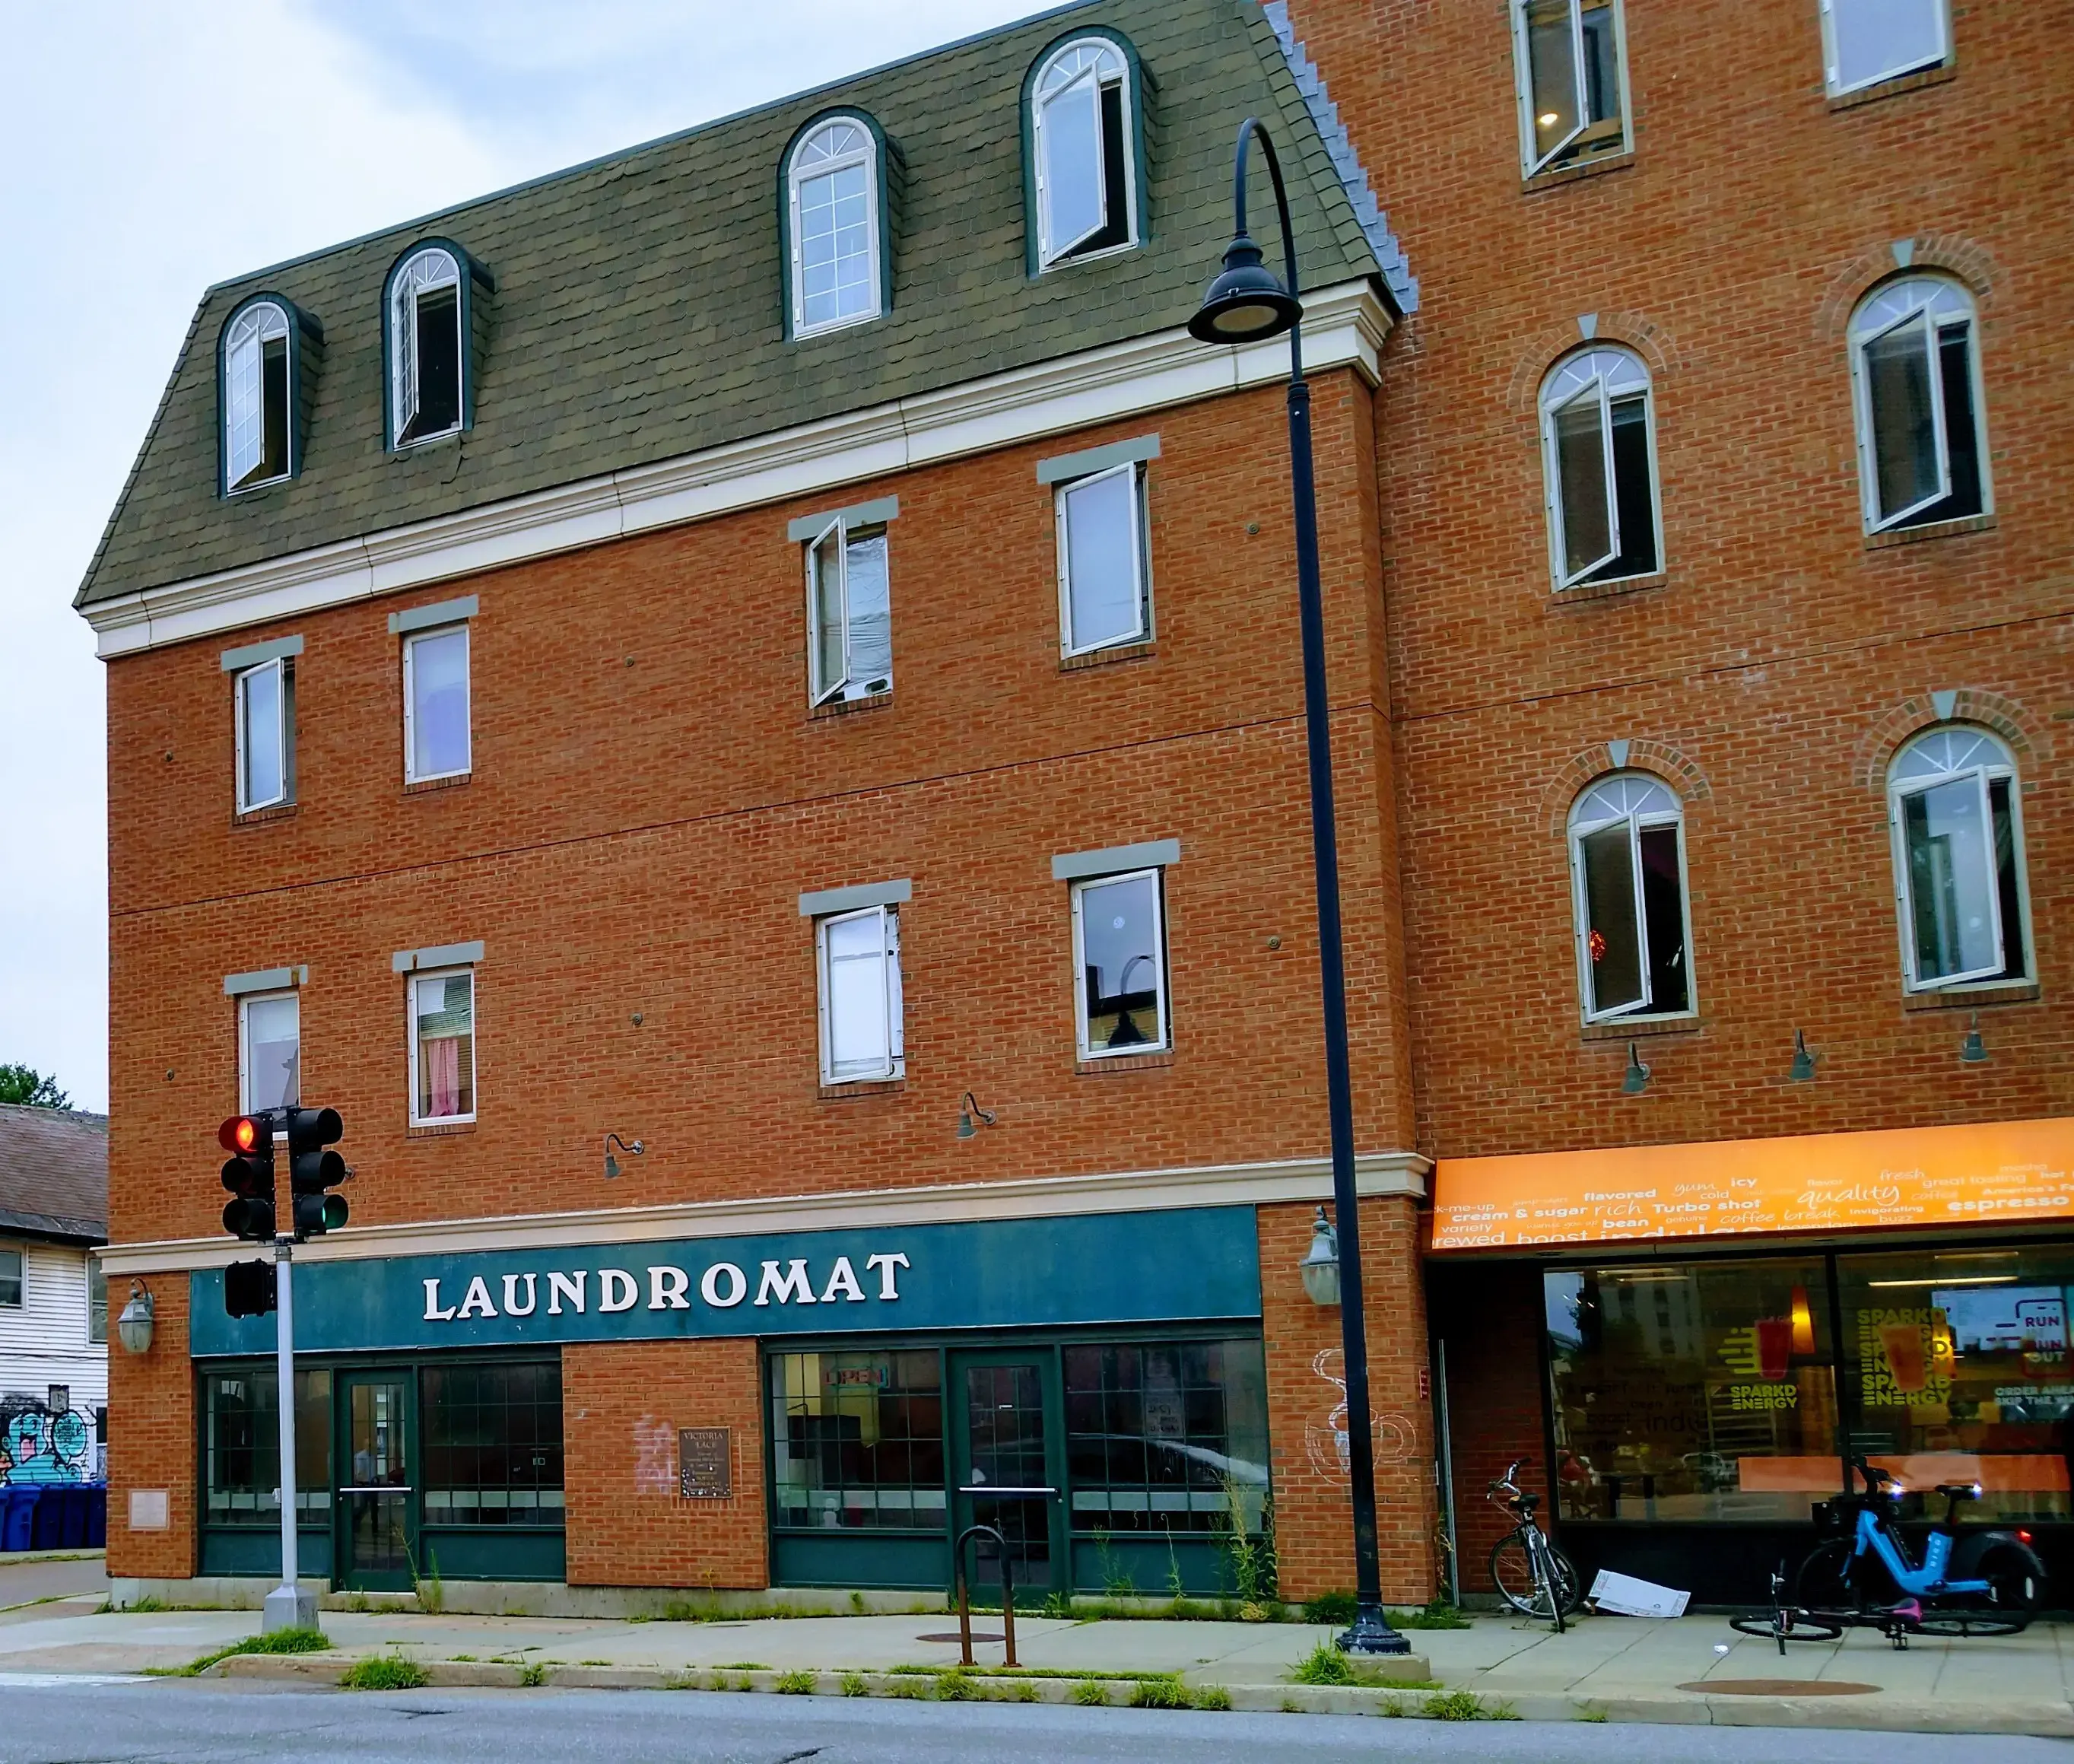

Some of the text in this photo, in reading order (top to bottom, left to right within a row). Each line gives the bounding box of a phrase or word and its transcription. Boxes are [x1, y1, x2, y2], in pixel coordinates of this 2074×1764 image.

[1879, 1168, 1925, 1181] fresh
[1922, 1174, 2027, 1189] great tasting
[1672, 1182, 1717, 1197] yum
[1730, 1177, 1758, 1188] icy
[1583, 1188, 1657, 1202] flavored
[1700, 1190, 1729, 1200] cold
[1797, 1183, 1900, 1210] quality
[1593, 1200, 1646, 1216] rich
[1652, 1199, 1761, 1214] Turbo shot
[1947, 1195, 2069, 1213] espresso
[1451, 1206, 1588, 1222] cream & sugar
[1720, 1207, 1841, 1224] coffee break
[1441, 1223, 1493, 1233] variety
[1602, 1219, 1650, 1228] bean
[1432, 1232, 1505, 1248] rewed
[422, 1252, 910, 1321] LAUNDROMAT
[2025, 1316, 2060, 1327] RUN
[1730, 1384, 1797, 1398] SPARKD
[1862, 1389, 1952, 1406] ENERGY
[1732, 1397, 1798, 1410] ENERGY
[684, 1432, 724, 1440] VICTORIA
